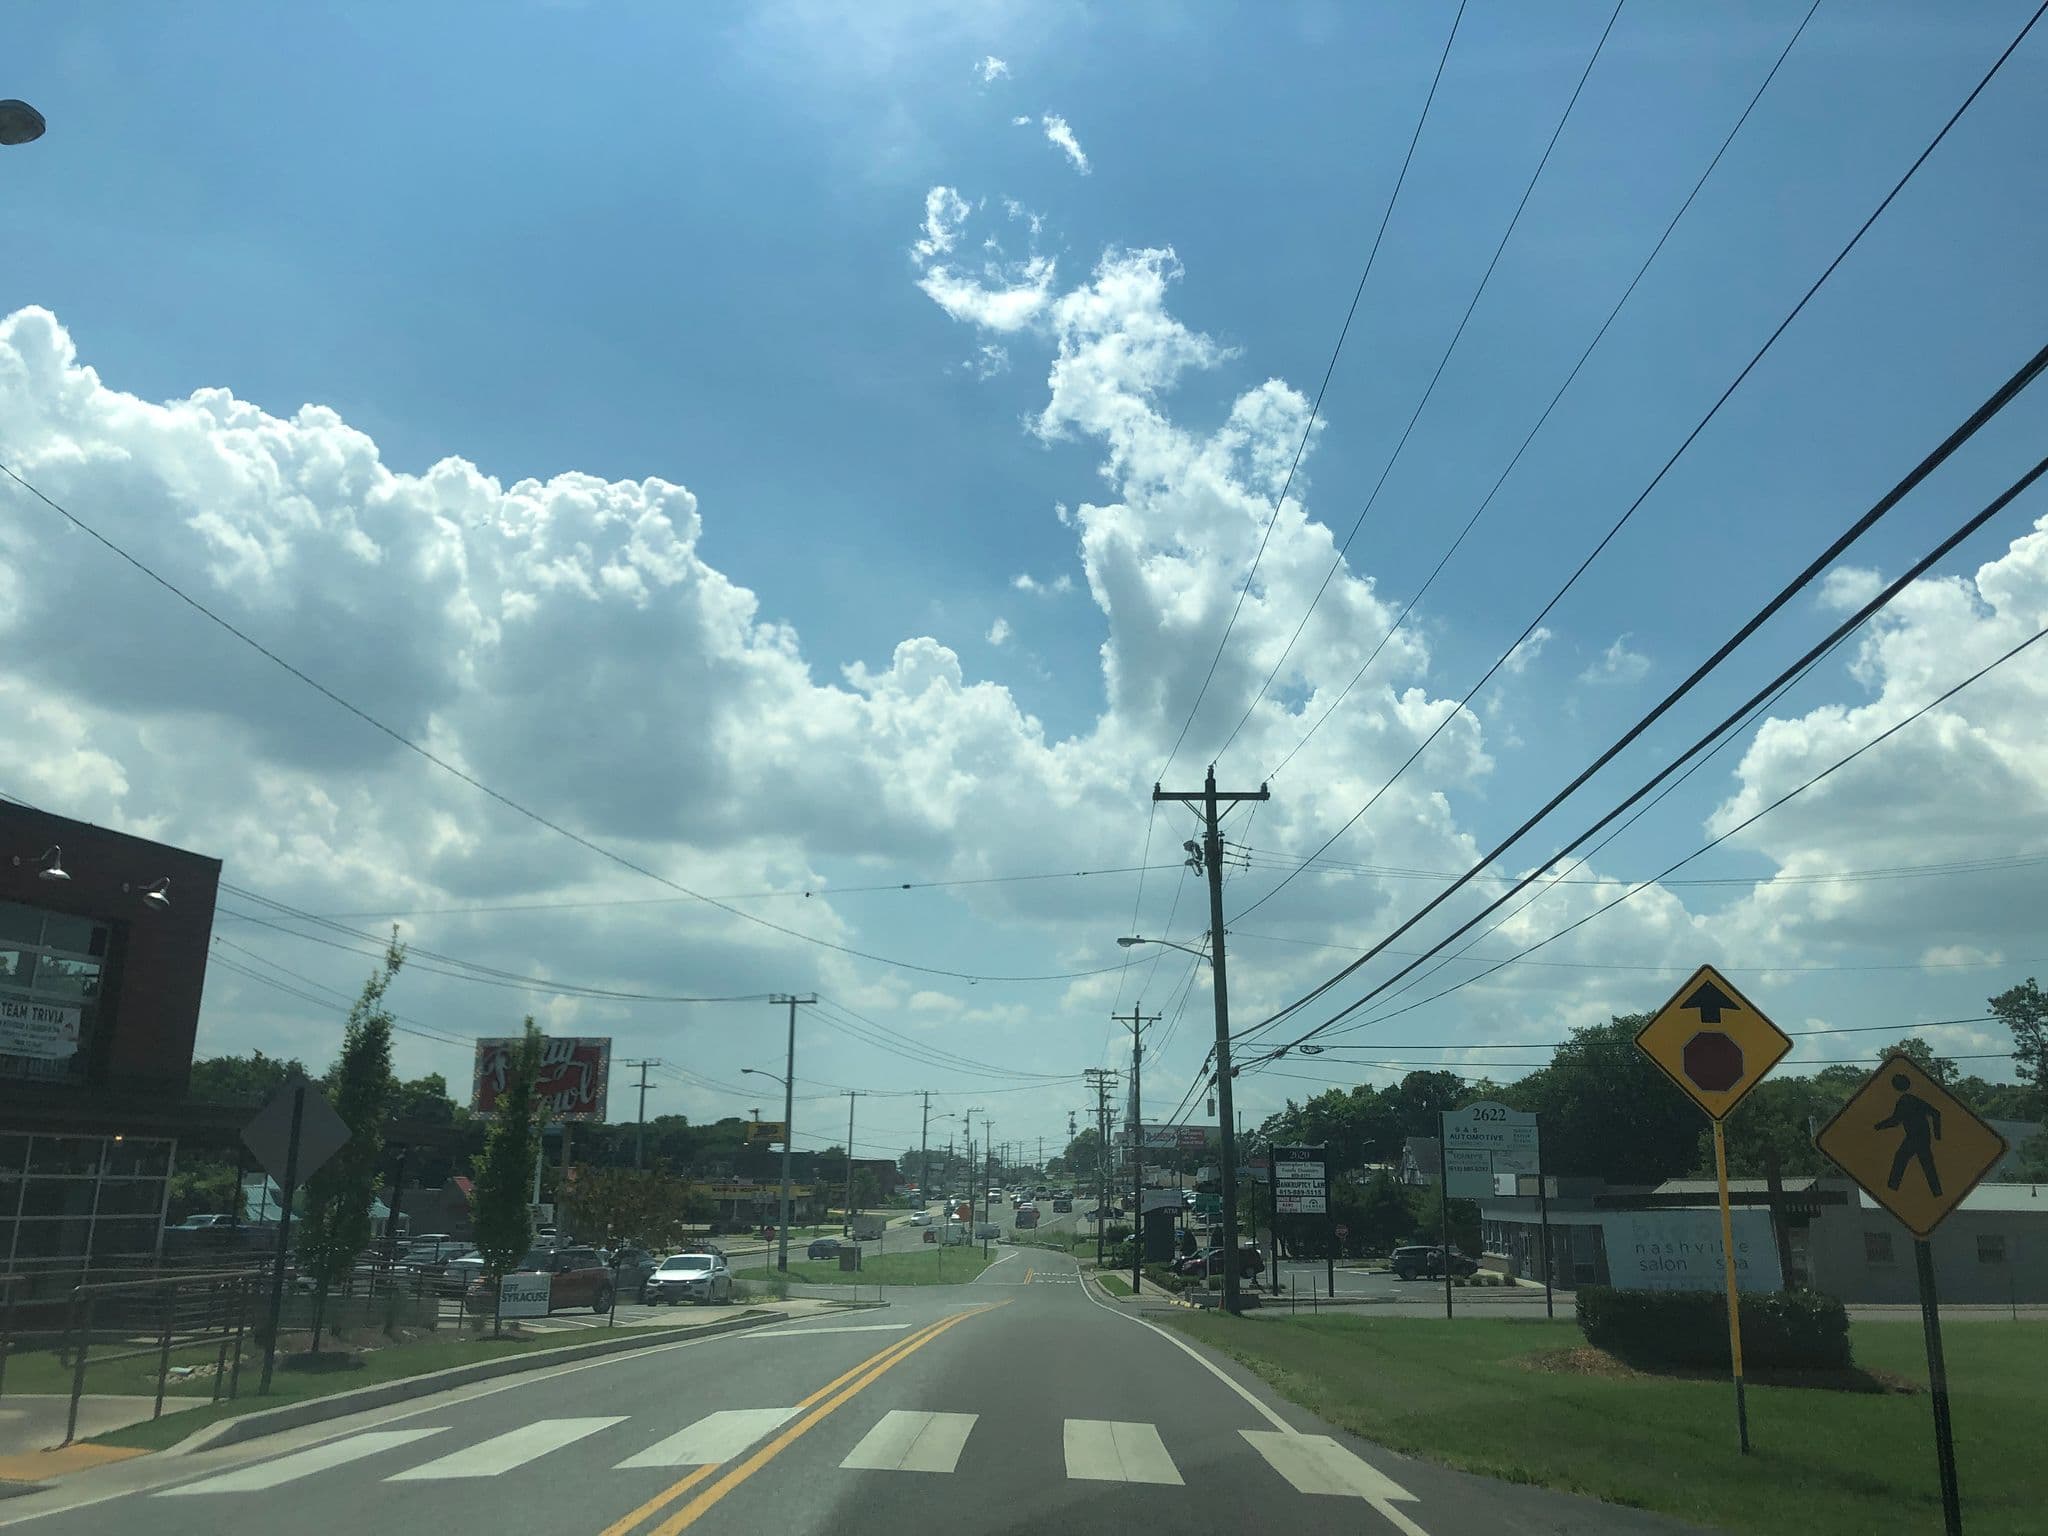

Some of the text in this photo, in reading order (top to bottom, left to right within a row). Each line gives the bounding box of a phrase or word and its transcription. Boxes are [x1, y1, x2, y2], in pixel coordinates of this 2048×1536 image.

[1, 1002, 65, 1024] TEAM TRIVIA
[1472, 1108, 1507, 1121] 2622
[1449, 1133, 1504, 1141] AUTOMOTIVE
[1635, 1239, 1750, 1254] nashvile
[1639, 1256, 1749, 1272] salon sa
[502, 1292, 548, 1302] SYRACUSE
